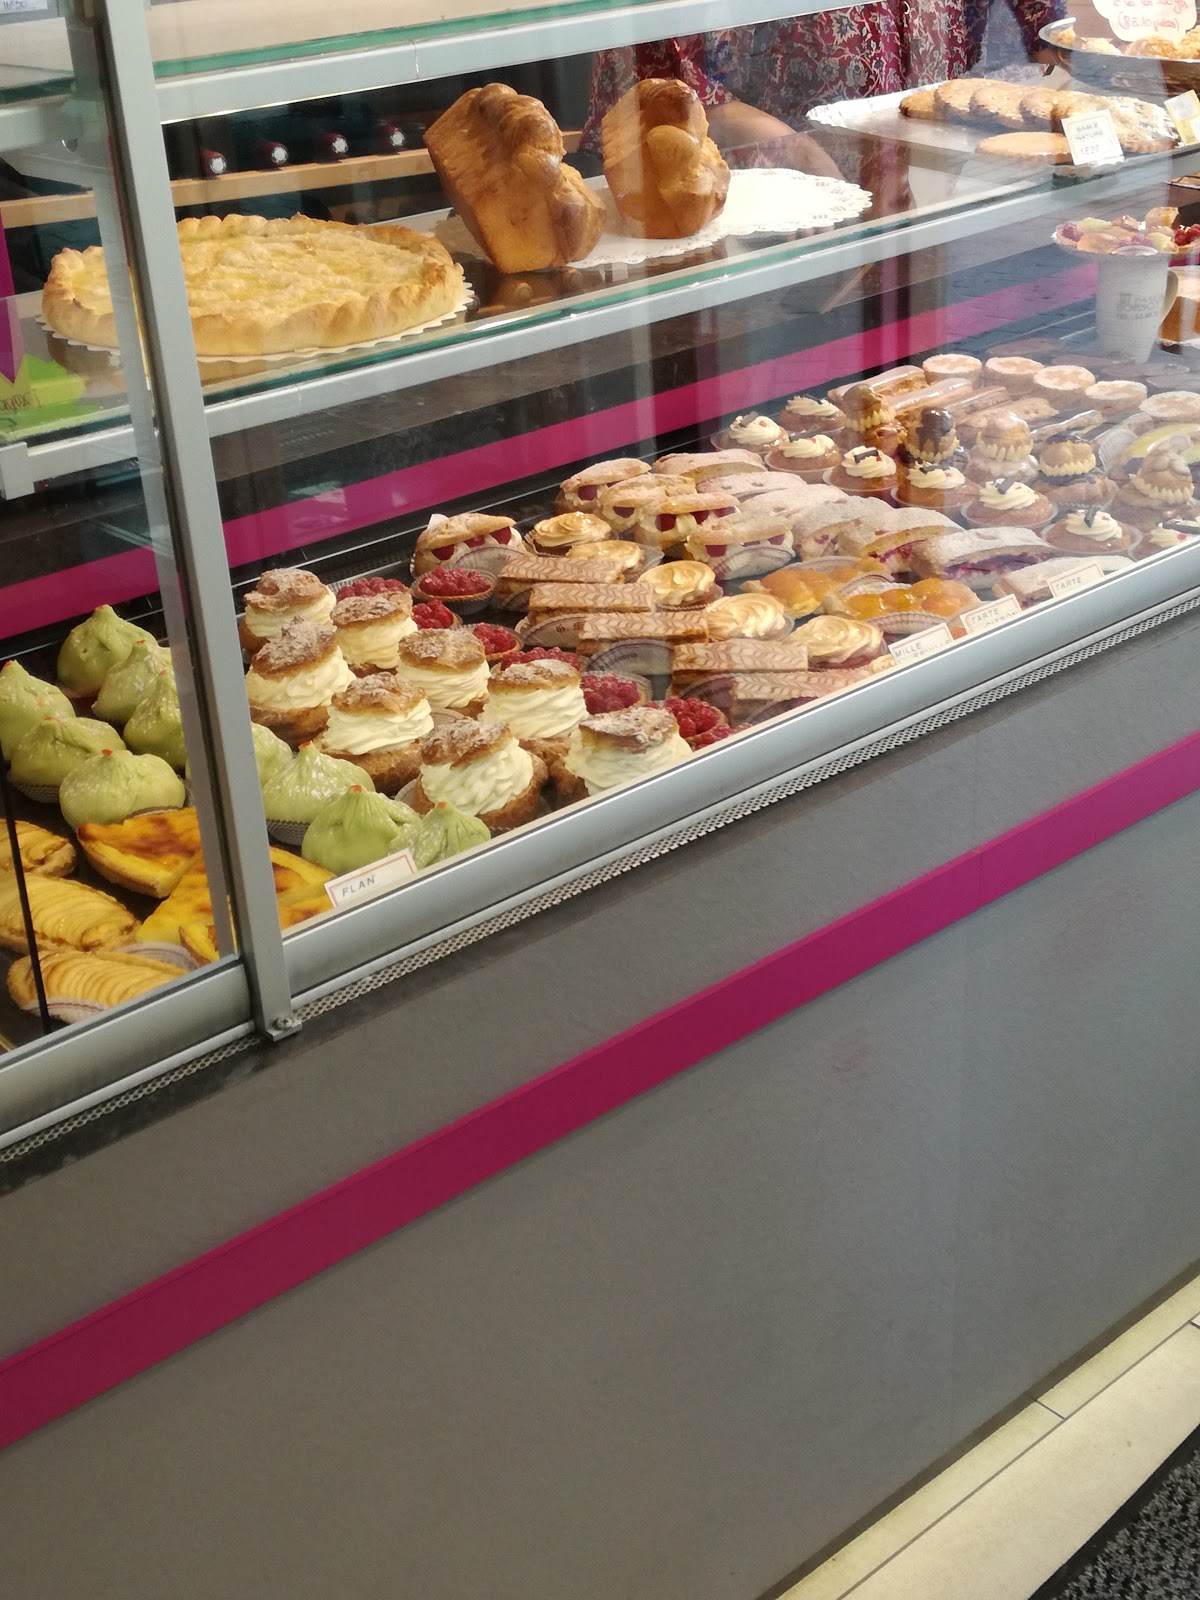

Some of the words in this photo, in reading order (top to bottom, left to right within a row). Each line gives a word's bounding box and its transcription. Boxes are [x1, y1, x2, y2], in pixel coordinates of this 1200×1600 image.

[1055, 576, 1082, 591] TARTE
[971, 607, 999, 624] TARTE
[894, 641, 922, 658] MILLE
[342, 875, 375, 897] FLAN
